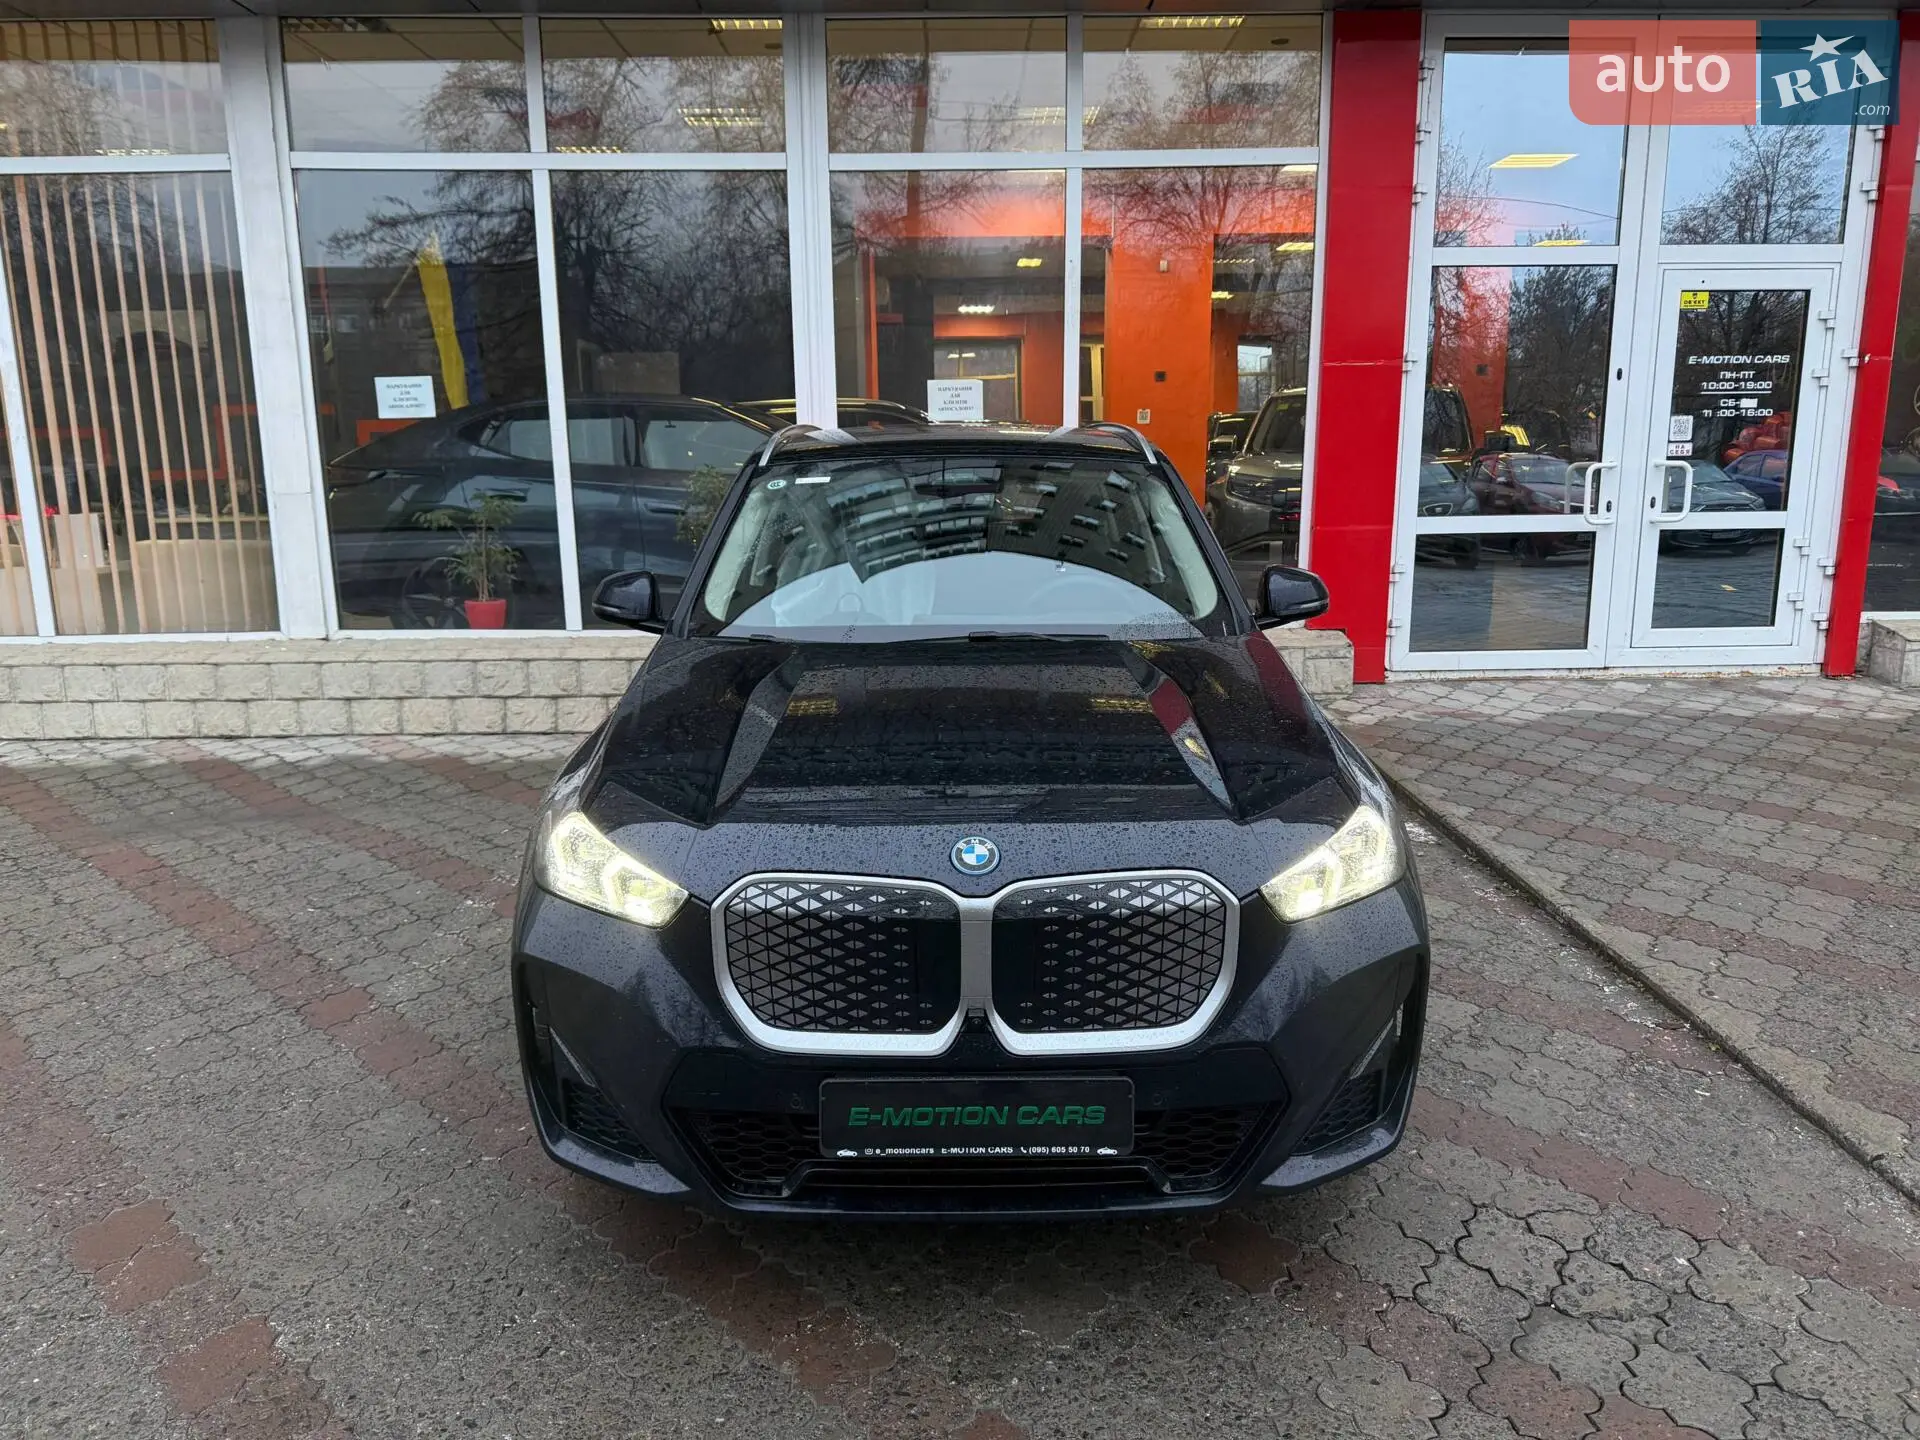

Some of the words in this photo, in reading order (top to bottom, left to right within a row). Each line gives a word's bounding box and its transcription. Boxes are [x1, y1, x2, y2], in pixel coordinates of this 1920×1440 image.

[1688, 355, 1753, 365] E-MOTION
[1754, 354, 1791, 364] CARS
[1719, 371, 1756, 380] ПН-ПТ
[1701, 381, 1773, 390] 10:00-19:00
[848, 1106, 1010, 1126] E-MOTION
[1016, 1105, 1106, 1125] CARS
[875, 1147, 934, 1156] e_motioncars
[1029, 1146, 1050, 1154] (095)
